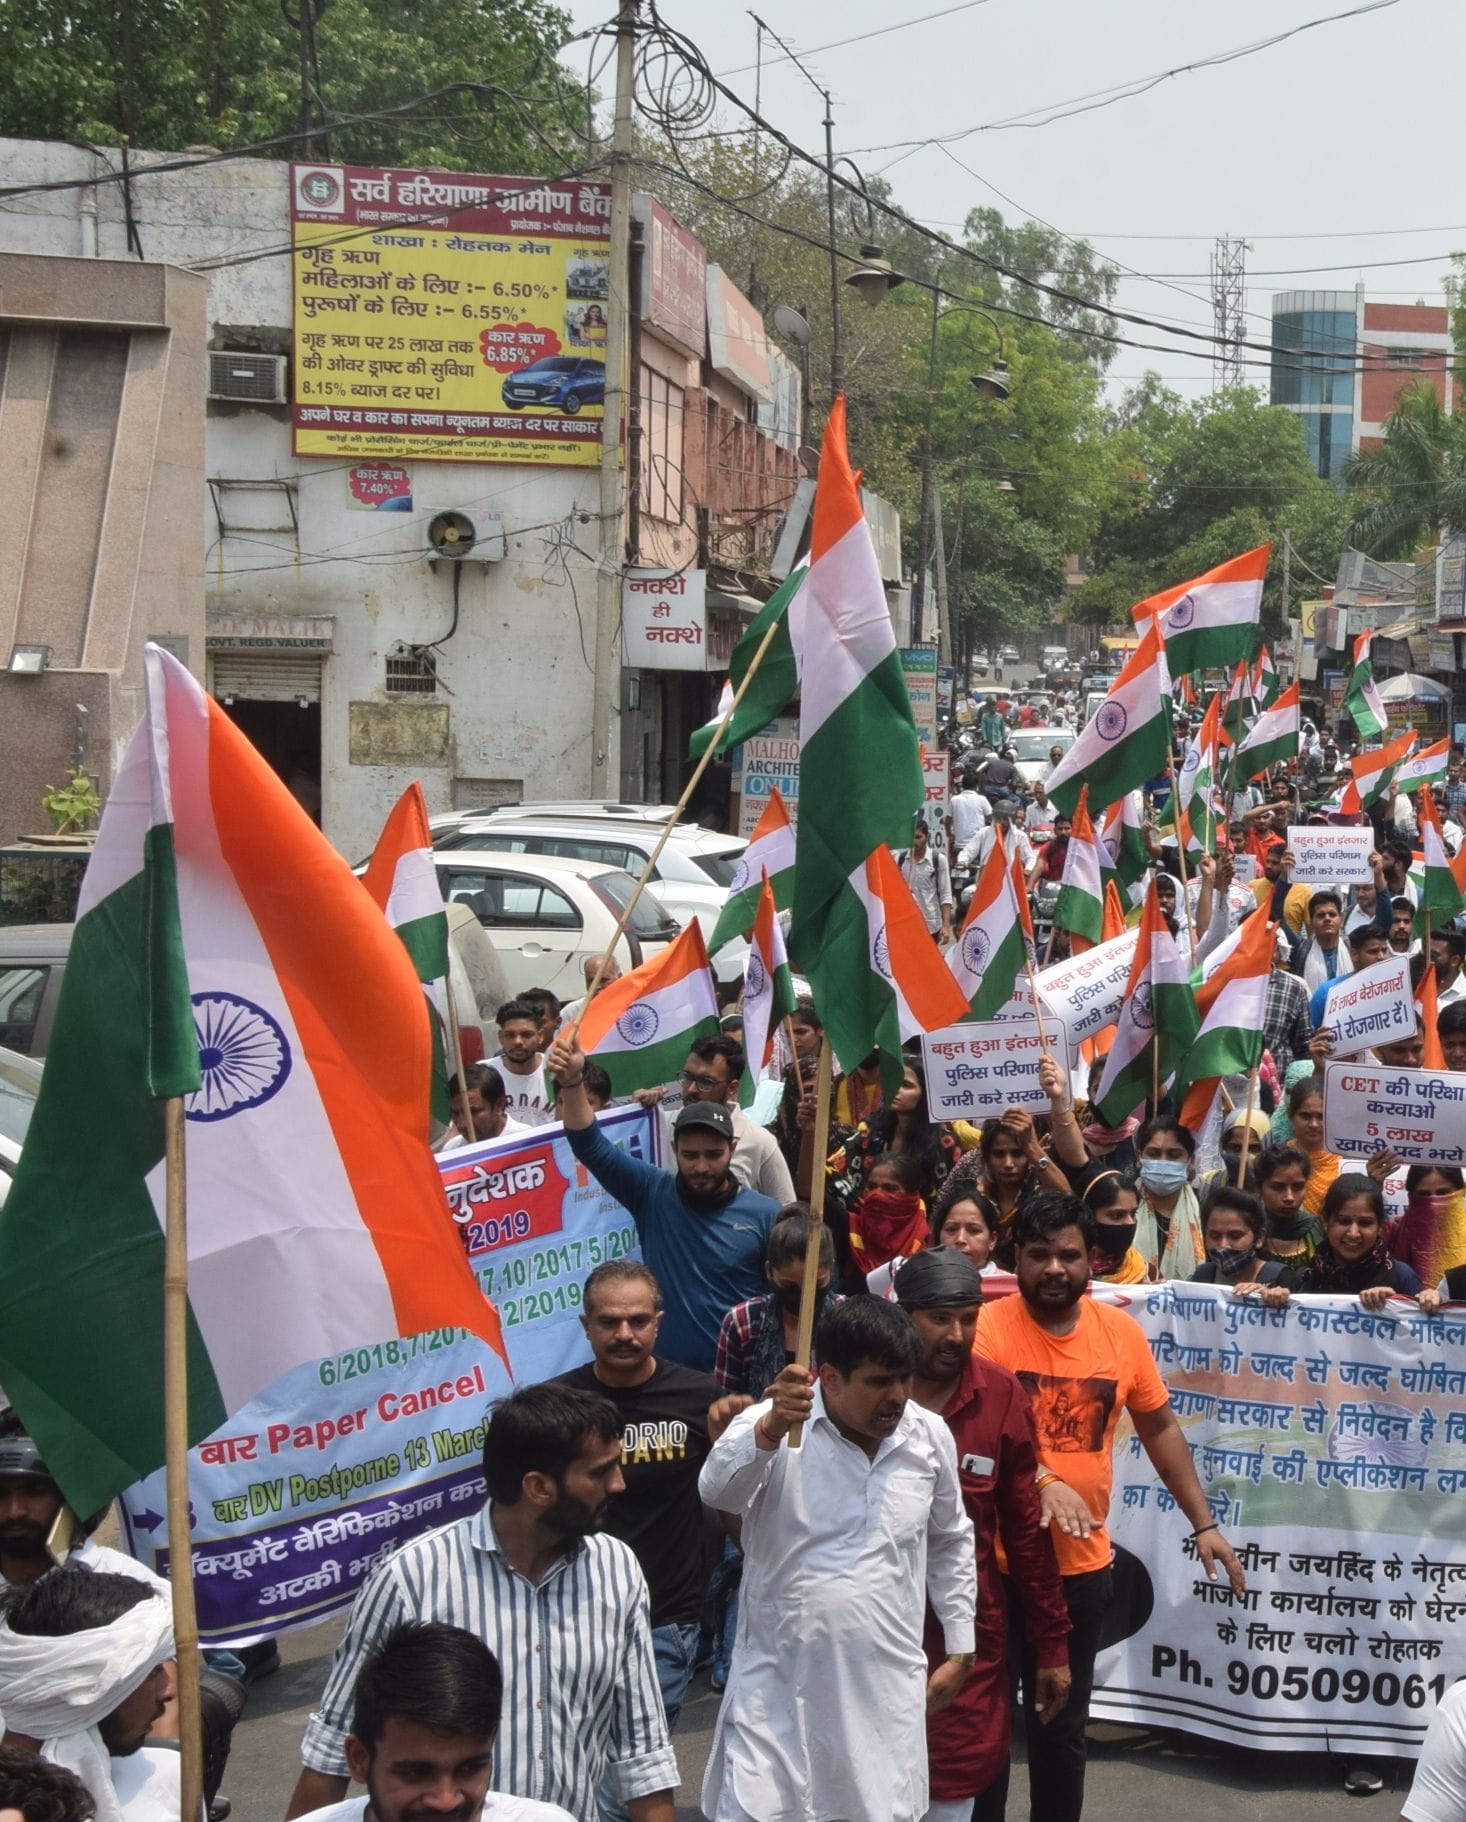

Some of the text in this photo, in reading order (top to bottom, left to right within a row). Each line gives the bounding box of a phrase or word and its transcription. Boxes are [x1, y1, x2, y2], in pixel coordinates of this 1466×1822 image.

[350, 174, 572, 215] सर्व हरियाणा ग्रामीण
[372, 234, 552, 255] शाखा रोहतक मेन
[302, 249, 381, 267] गृह ऋण
[302, 269, 459, 295] महिलाओं के लिए
[364, 298, 427, 317] के लिए
[302, 333, 473, 354] गृह ऋण पर 25 लाख तक
[488, 331, 544, 345] कार ऋण
[302, 354, 474, 386] की ओवर की सुविधा
[303, 381, 413, 400] 8.15% ब्याज दर
[300, 406, 597, 435] अपने घर कार का सपना न्यूनतम साकार
[357, 469, 378, 480] कार
[629, 574, 687, 596] नक्शे
[652, 601, 671, 618] ही
[645, 620, 703, 645] नक्शे
[747, 740, 800, 760] MALHO
[747, 760, 800, 775] ARCHITE
[750, 777, 800, 794] ONLI
[1294, 835, 1368, 848] बहुत हुआ इंतजार
[1300, 850, 1360, 863] पुलिस परिणाम
[1296, 866, 1316, 875] जारी
[1318, 867, 1333, 875] करे
[1043, 958, 1103, 994] बहुत हुआ
[1068, 980, 1107, 1012] पुलिस
[1072, 1009, 1102, 1034] जारी
[1345, 1010, 1390, 1040] रोजगार
[931, 1034, 1059, 1061] बहुत हुआ इंतजार
[945, 1064, 988, 1087] पुलिस
[940, 1091, 1004, 1107] जारी करे
[1341, 1076, 1466, 1101] CET की परिक्षा
[505, 1094, 556, 1115] RDAN
[1367, 1099, 1436, 1119] करवाओ
[1367, 1122, 1435, 1143] 5 लाख
[1335, 1137, 1464, 1161] खाली भरो
[445, 1158, 546, 1224] नुदेशक
[469, 1209, 530, 1251] 2019
[1224, 1296, 1290, 1334] पुलिस
[1297, 1302, 1398, 1340] कांस्टेबल
[1218, 1342, 1242, 1374] को
[1251, 1352, 1298, 1382] जल्द
[1306, 1351, 1330, 1384] से
[1339, 1360, 1392, 1392] जल्द
[199, 1365, 486, 1466] बार Paper Cancel
[1216, 1397, 1294, 1430] सरकार
[1302, 1400, 1328, 1434] से
[1338, 1403, 1412, 1442] निवेदन
[1420, 1408, 1437, 1446] है
[213, 1436, 432, 1523] बार DV Postporne 13
[1202, 1444, 1264, 1486] सुनवाई
[1272, 1450, 1308, 1483] की
[1316, 1454, 1429, 1492] एप्लीकेशन
[1123, 1484, 1150, 1508] का
[292, 1490, 445, 1553] वेरिफिकेशन
[1289, 1551, 1377, 1583] जयहिंद
[1383, 1553, 1402, 1581] के
[258, 1561, 341, 1605] अटकी
[1270, 1586, 1382, 1620] कार्यालय
[1389, 1592, 1414, 1621] को
[1217, 1618, 1444, 1663] के लिए चलो रोहतक
[1151, 1645, 1213, 1688] Ph.
